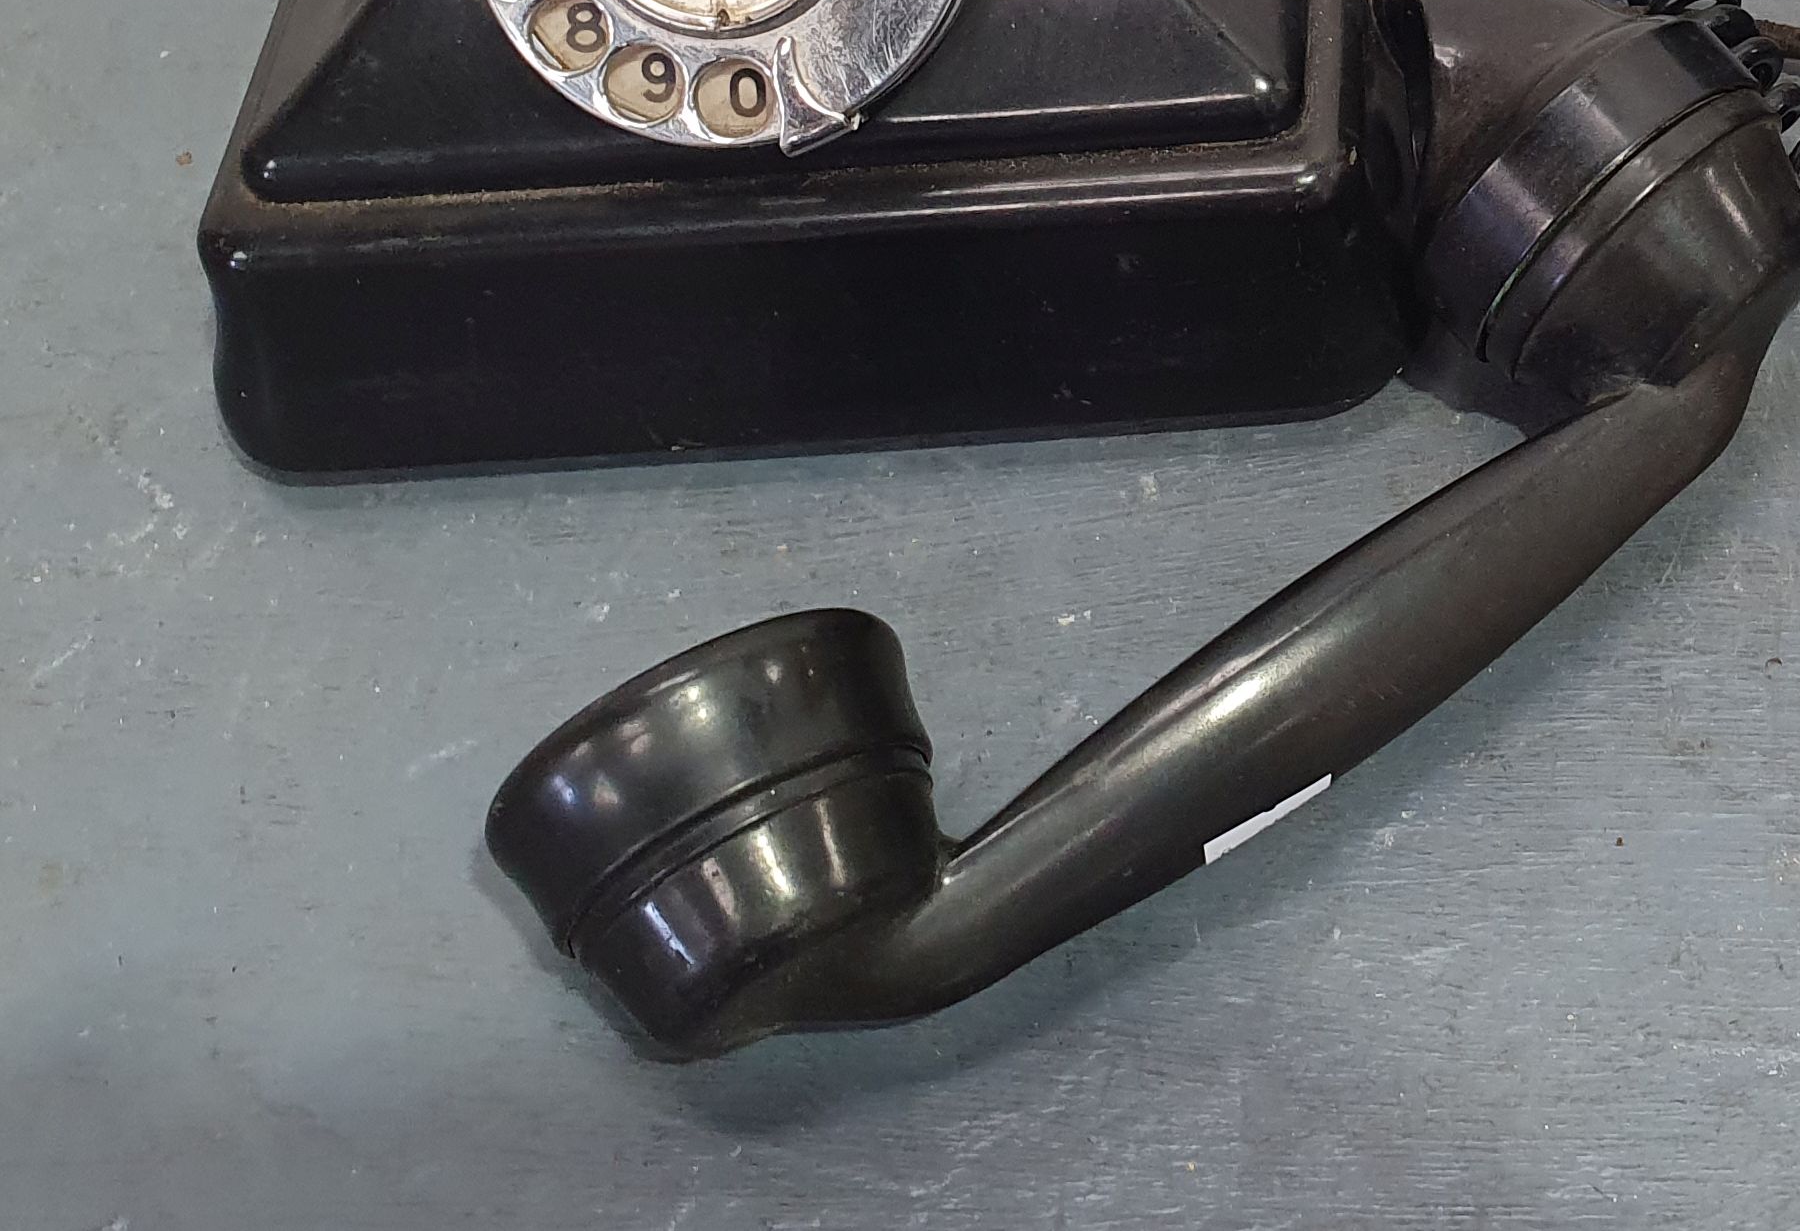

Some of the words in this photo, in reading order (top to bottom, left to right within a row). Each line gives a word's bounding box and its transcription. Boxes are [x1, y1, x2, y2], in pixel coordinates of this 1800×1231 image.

[566, 1, 602, 53] 8
[641, 51, 676, 103] 9
[728, 67, 766, 117] 0
